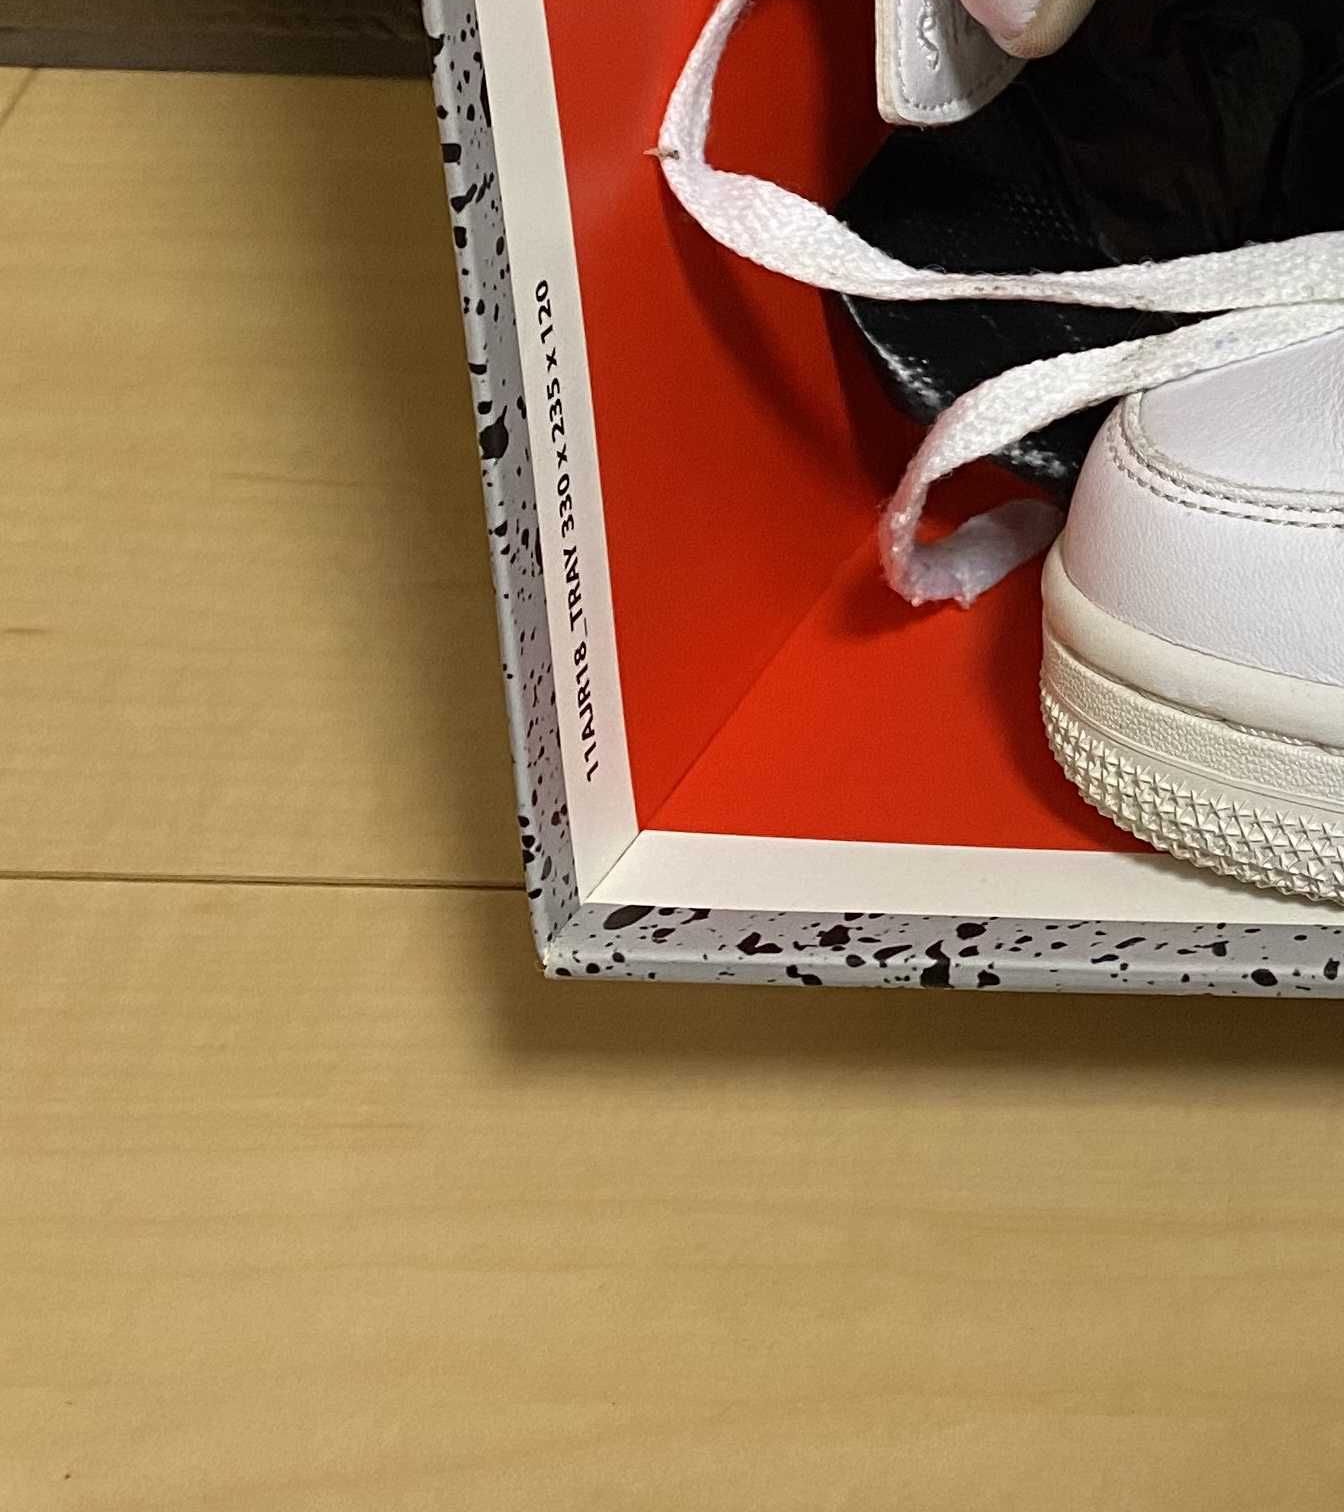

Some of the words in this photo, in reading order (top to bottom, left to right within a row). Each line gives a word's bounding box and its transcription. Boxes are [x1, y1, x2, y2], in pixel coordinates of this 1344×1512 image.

[535, 279, 554, 345] 120
[546, 377, 565, 444] 235
[557, 473, 575, 539] 330
[562, 545, 600, 785] 11AJR18_TRAY
